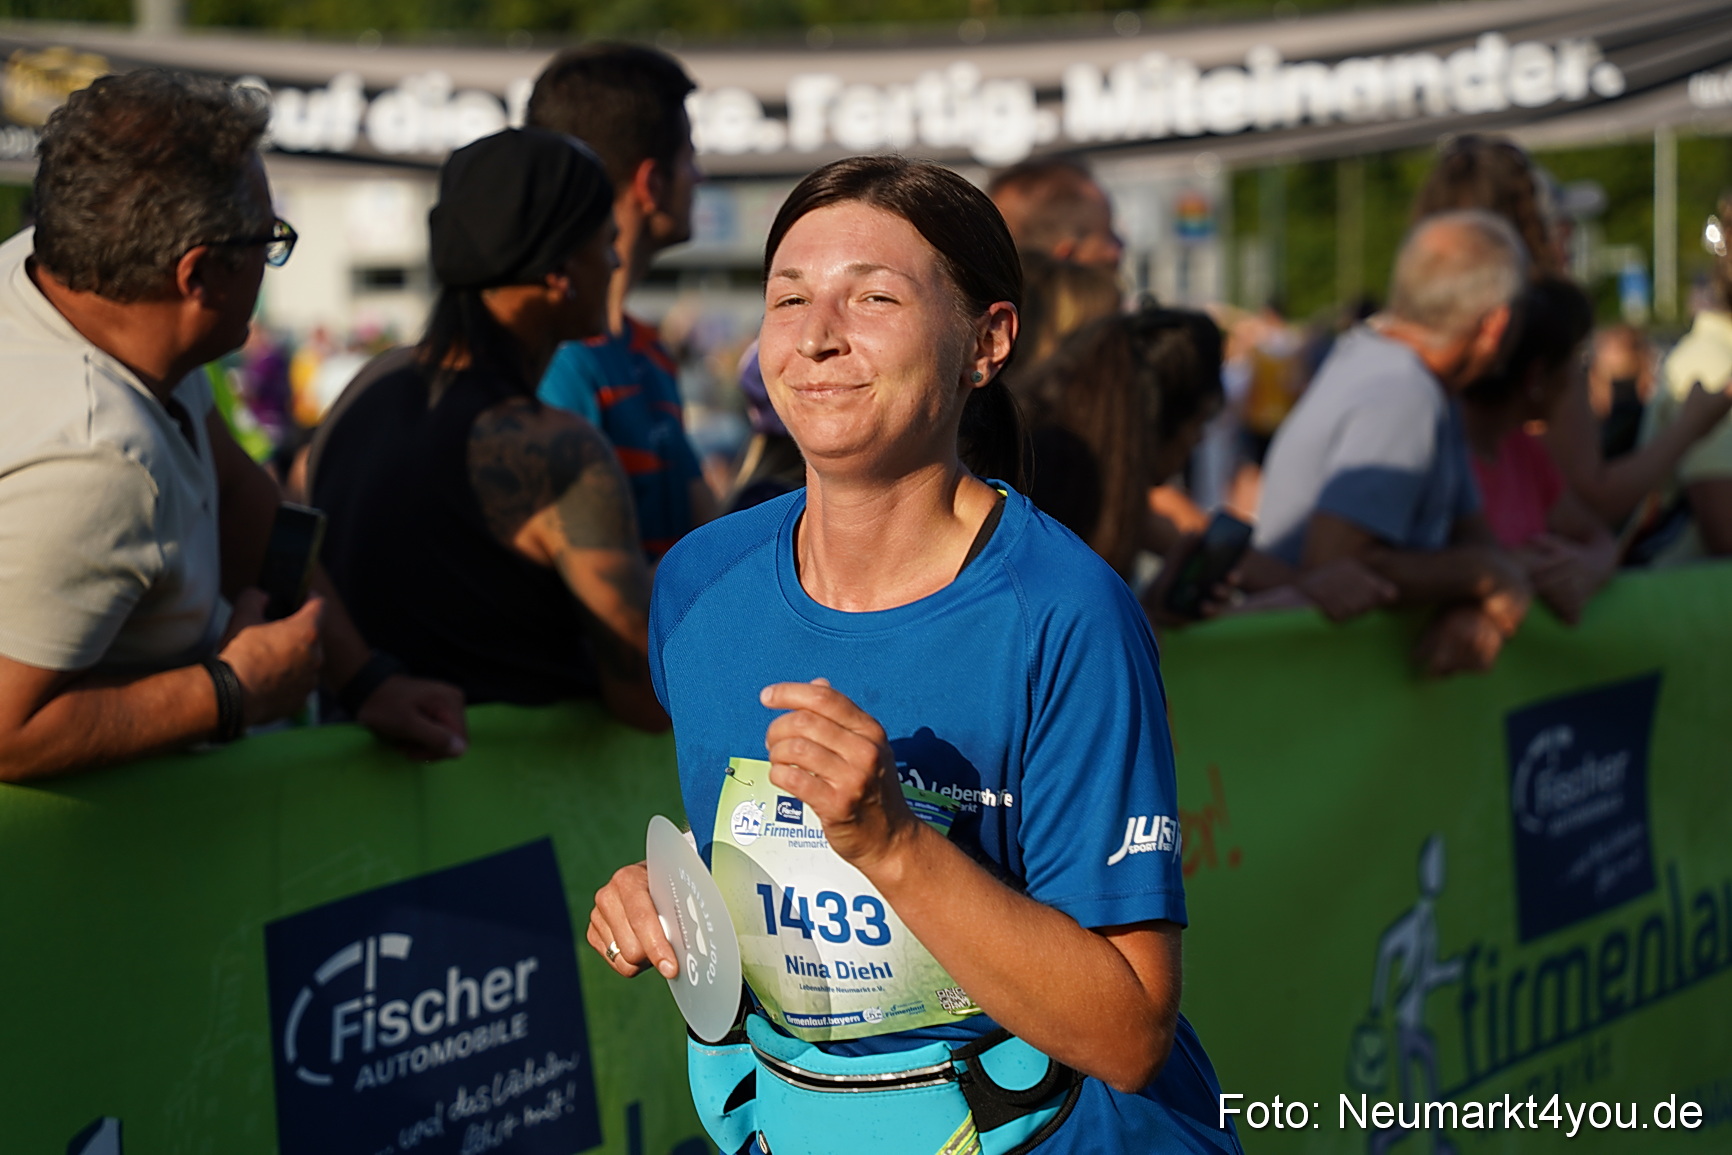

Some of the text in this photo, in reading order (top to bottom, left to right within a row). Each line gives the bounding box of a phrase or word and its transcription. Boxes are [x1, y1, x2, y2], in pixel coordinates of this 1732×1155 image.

[1063, 30, 1626, 141] Miteinander.
[238, 73, 364, 153] uf
[763, 823, 824, 839] Firmenlau
[788, 840, 828, 849] neumarkt
[1128, 842, 1158, 854] SPORT
[756, 882, 892, 947] 1433
[784, 953, 894, 981] Nina Diehl
[799, 983, 885, 994] Lebenshilfe Neumarkt e.V.
[330, 956, 539, 1064] Fischer
[786, 1013, 861, 1027] firmenlauf.bayern
[354, 1011, 529, 1093] AUTOMOBILE
